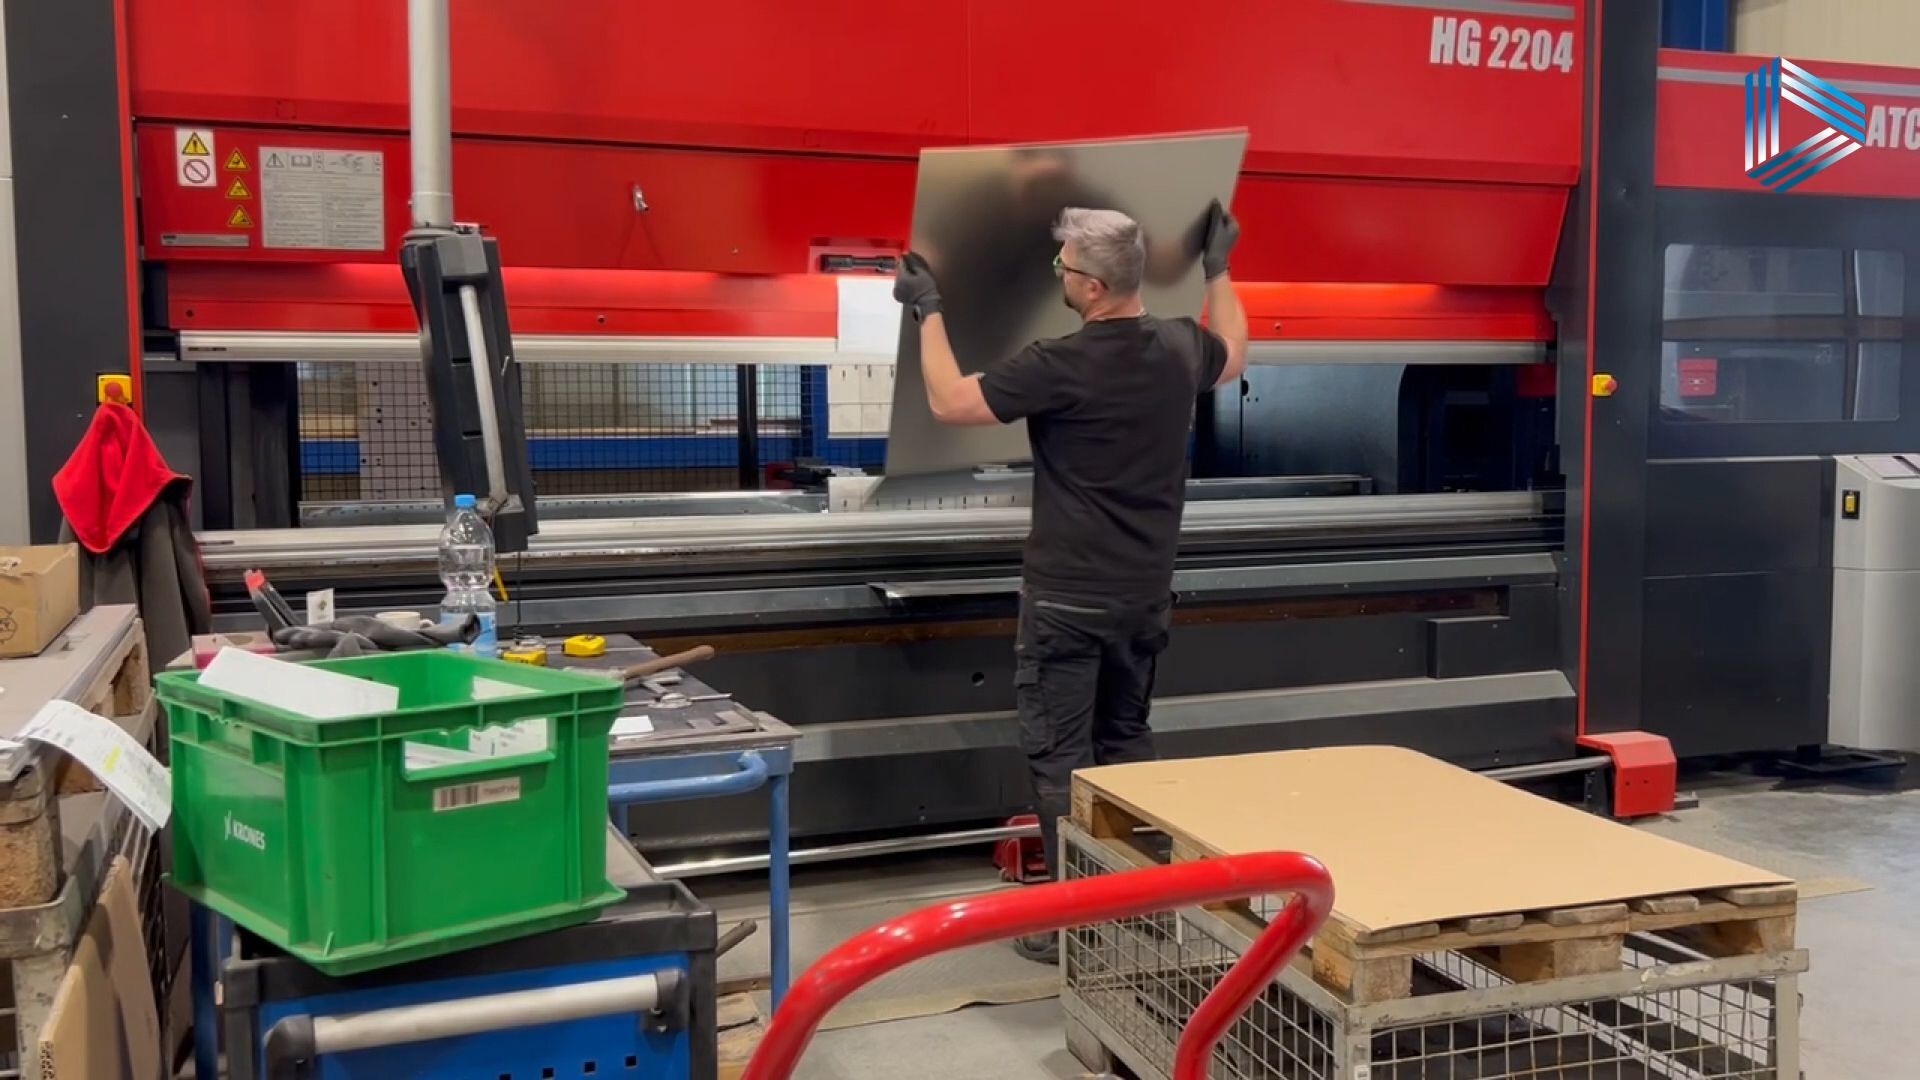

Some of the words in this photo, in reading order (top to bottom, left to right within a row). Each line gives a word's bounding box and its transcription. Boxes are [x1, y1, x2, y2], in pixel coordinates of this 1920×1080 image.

[1430, 15, 1482, 66] HG
[1487, 24, 1574, 73] 2204
[232, 819, 265, 850] KRONES
